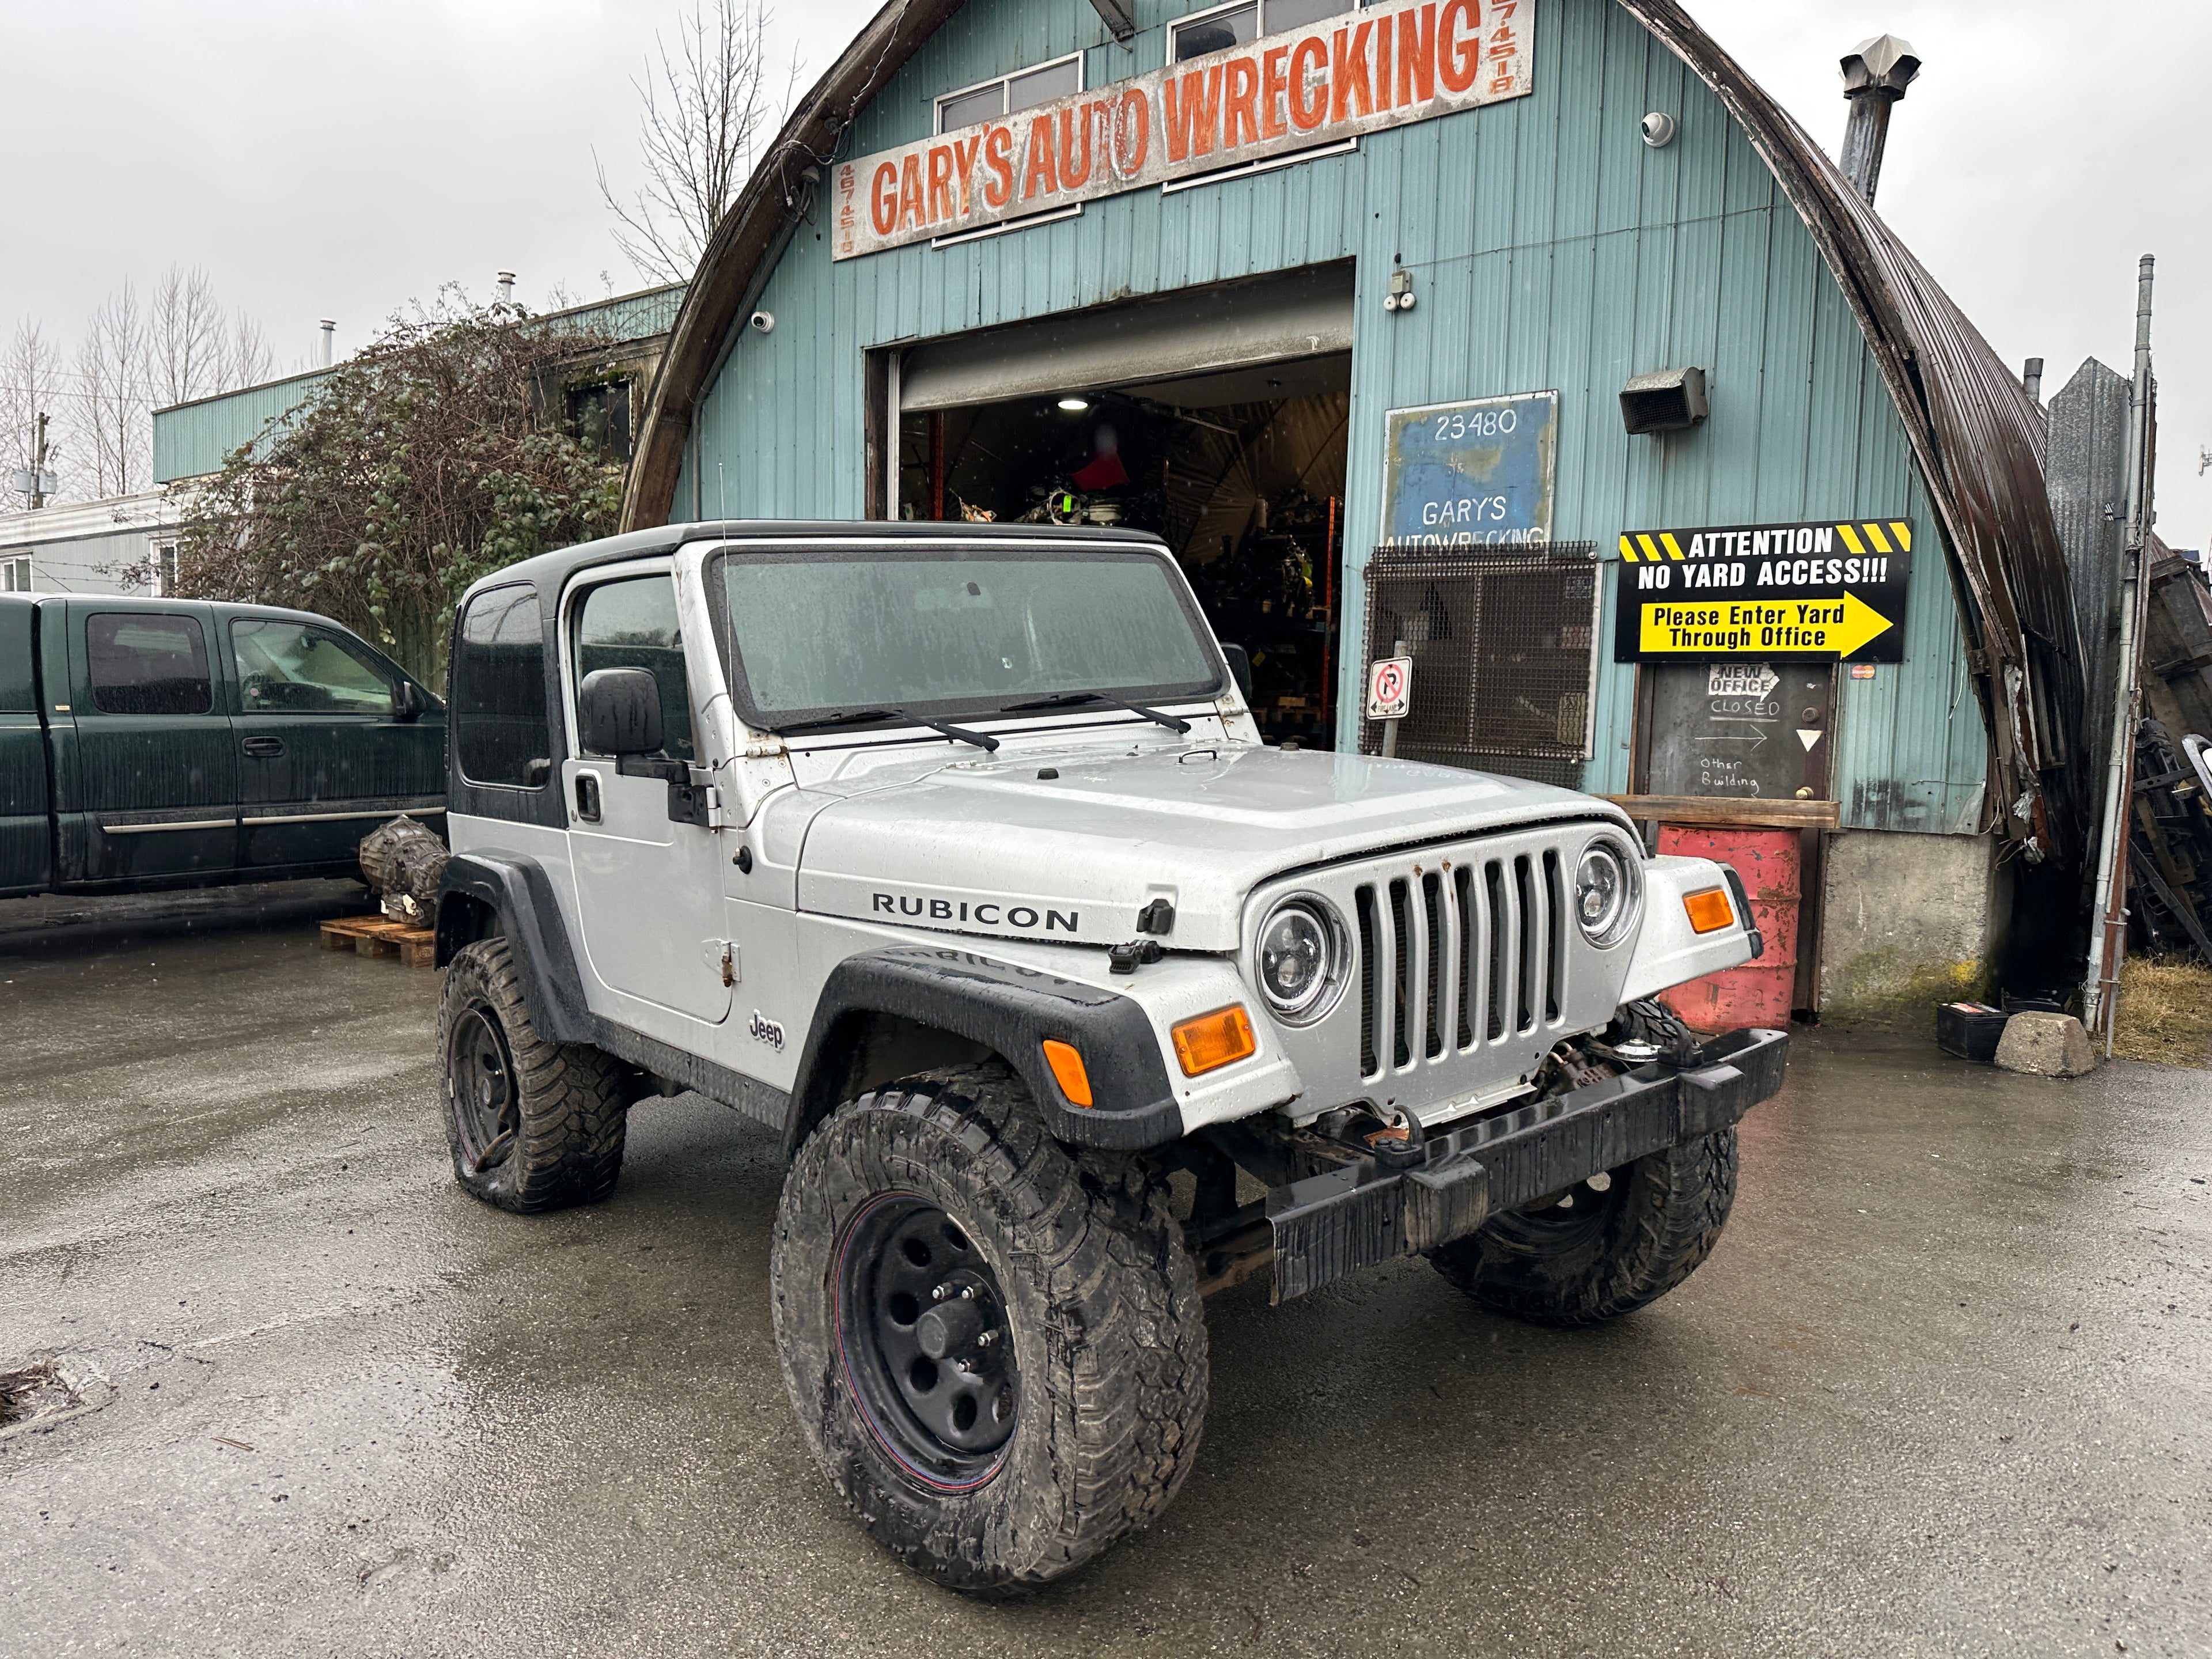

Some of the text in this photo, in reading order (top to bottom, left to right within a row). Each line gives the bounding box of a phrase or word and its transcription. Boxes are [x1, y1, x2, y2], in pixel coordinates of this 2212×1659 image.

[871, 0, 1480, 236] GARY'S AUTO WRECKING
[1435, 409, 1517, 441] 23480
[1423, 496, 1506, 525] GARY'S
[1688, 528, 1833, 558] ATTENTION
[1638, 558, 1888, 589] NO YARD ACCESS!!!
[1654, 604, 1844, 626] Please Enter Yard
[1669, 626, 1825, 650] Through Office
[1711, 679, 1770, 691] OFFICE
[1720, 665, 1762, 678] NEW
[1711, 700, 1779, 715] CLOSED
[1702, 771, 1759, 795] Building
[873, 893, 1079, 932] RUBICON
[749, 1013, 782, 1049] Jeep
